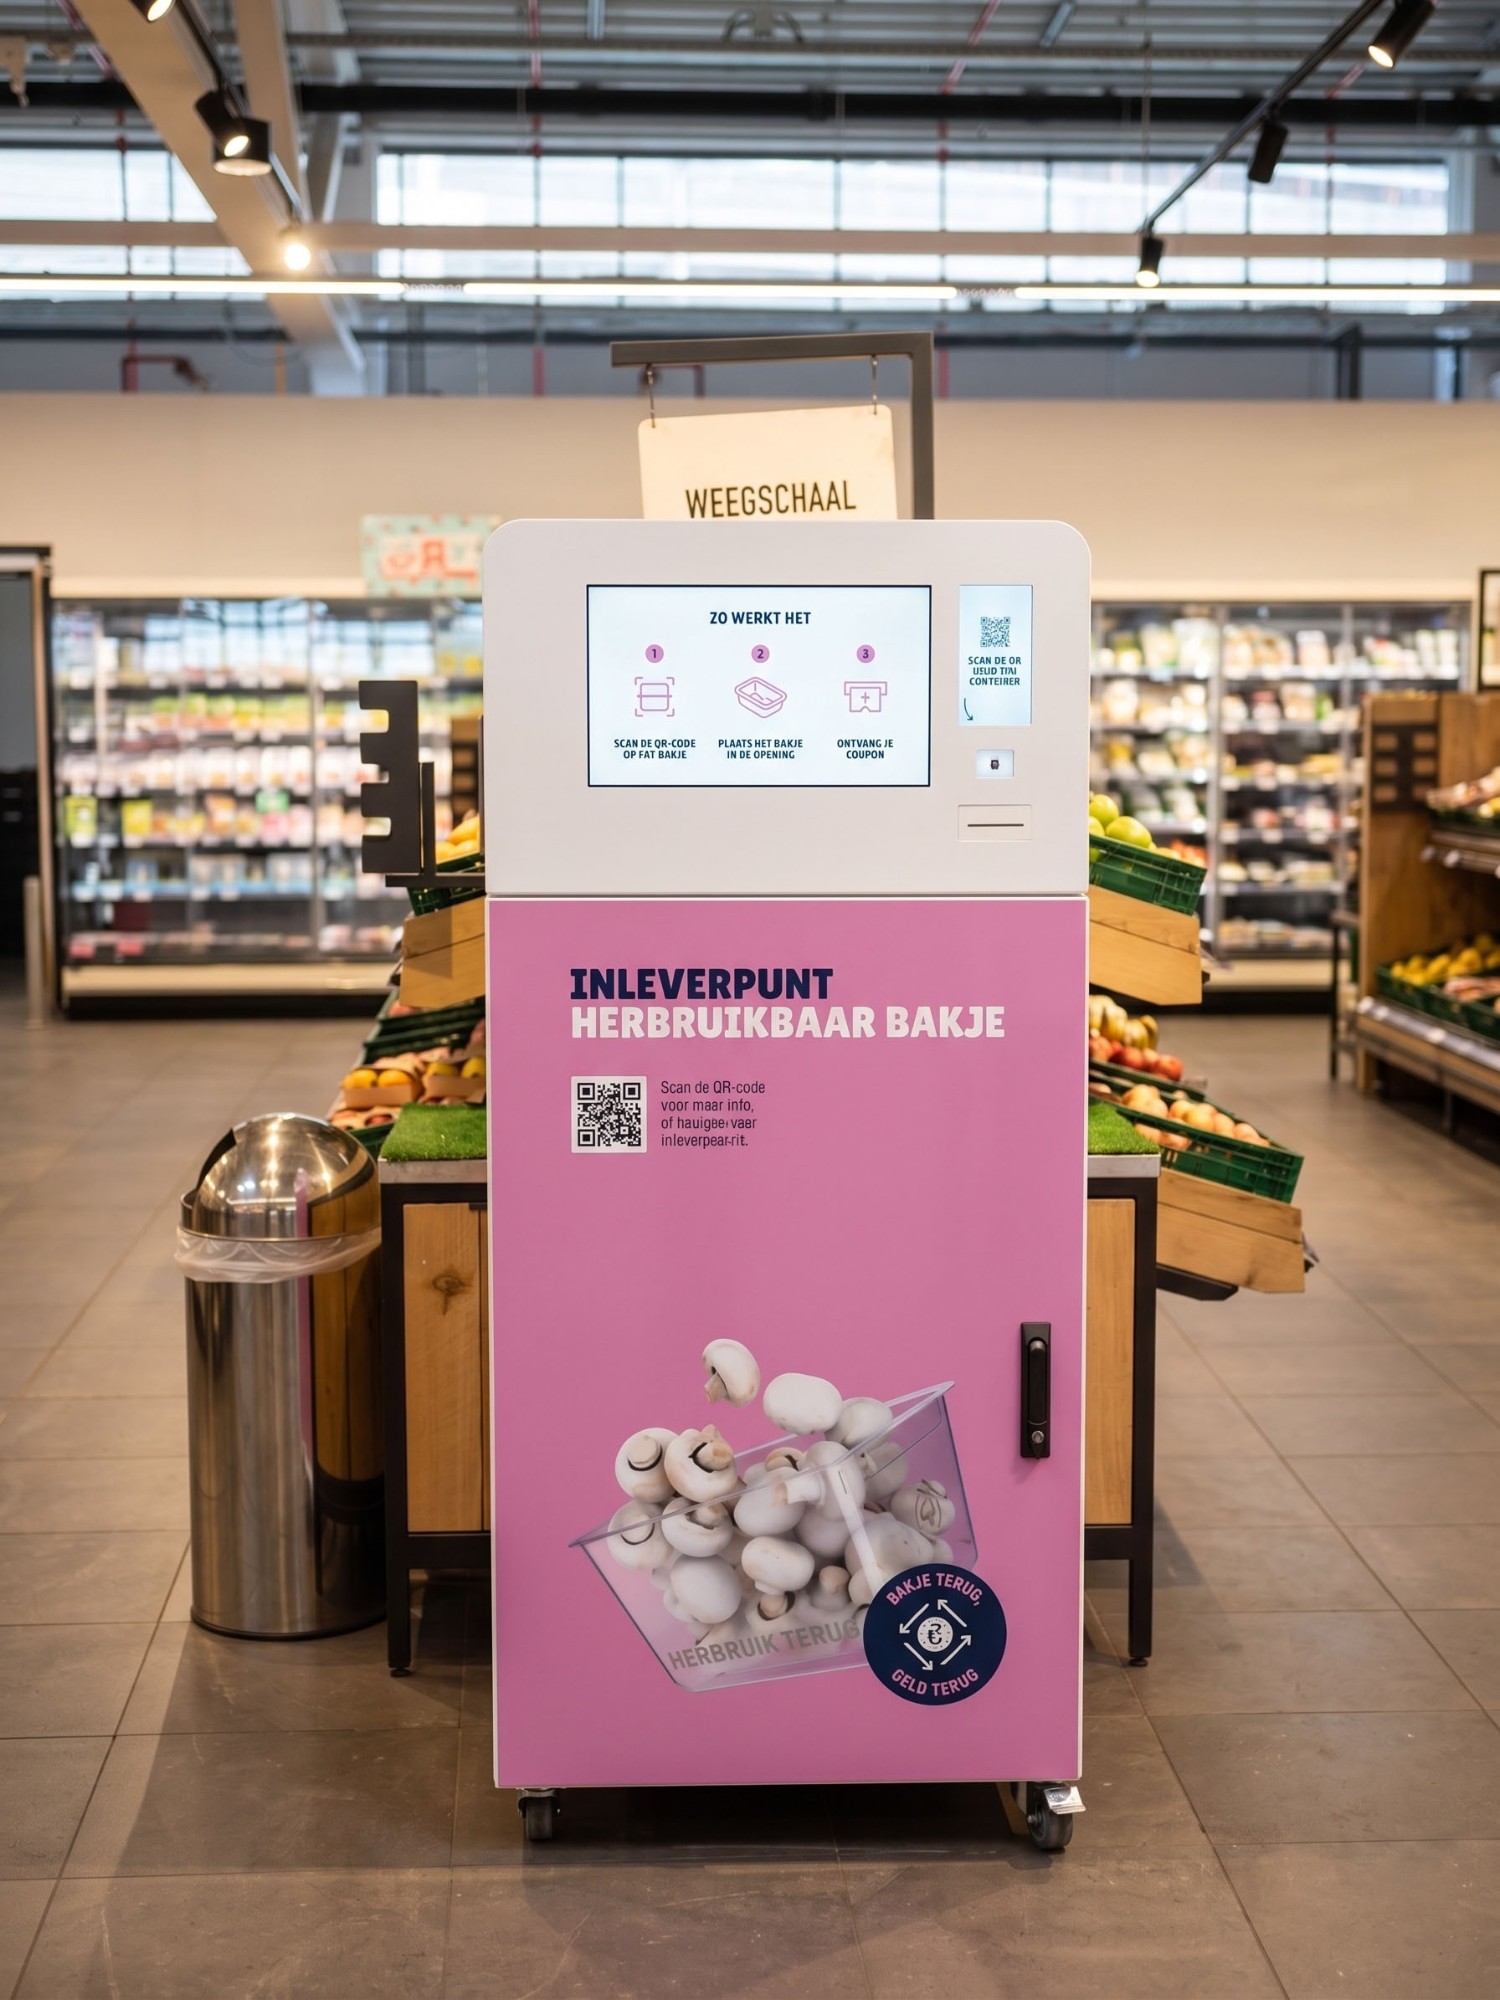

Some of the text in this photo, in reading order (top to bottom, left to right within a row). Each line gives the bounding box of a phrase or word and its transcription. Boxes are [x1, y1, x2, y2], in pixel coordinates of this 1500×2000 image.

[685, 480, 857, 519] WEEGSCHAAL
[709, 612, 812, 625] ZO WERKT HET
[756, 648, 765, 659] 2
[861, 648, 870, 659] 3
[968, 656, 992, 665] SCAN
[994, 656, 1007, 665] DE
[614, 739, 696, 749] SCAN DE QR-CODE
[718, 739, 804, 748] PLAATS HET BAKJE
[837, 739, 894, 748] ONTVANG JE
[623, 750, 687, 759] OP FAT BAKJE
[726, 750, 795, 759] IN DE OPENING
[846, 750, 885, 759] COUPON
[570, 968, 834, 1000] INLEVERPUNT
[571, 1006, 1006, 1039] HERBRUIKBAAR BAKJE
[660, 1080, 766, 1094] Scan de QR-code
[660, 1099, 754, 1113] voor maar info,
[661, 1116, 674, 1129] of
[886, 1572, 983, 1607] BAKJE TERUG,
[667, 1619, 861, 1671] HERBRUIK TERUG
[891, 1668, 979, 1697] GELD TERUG
